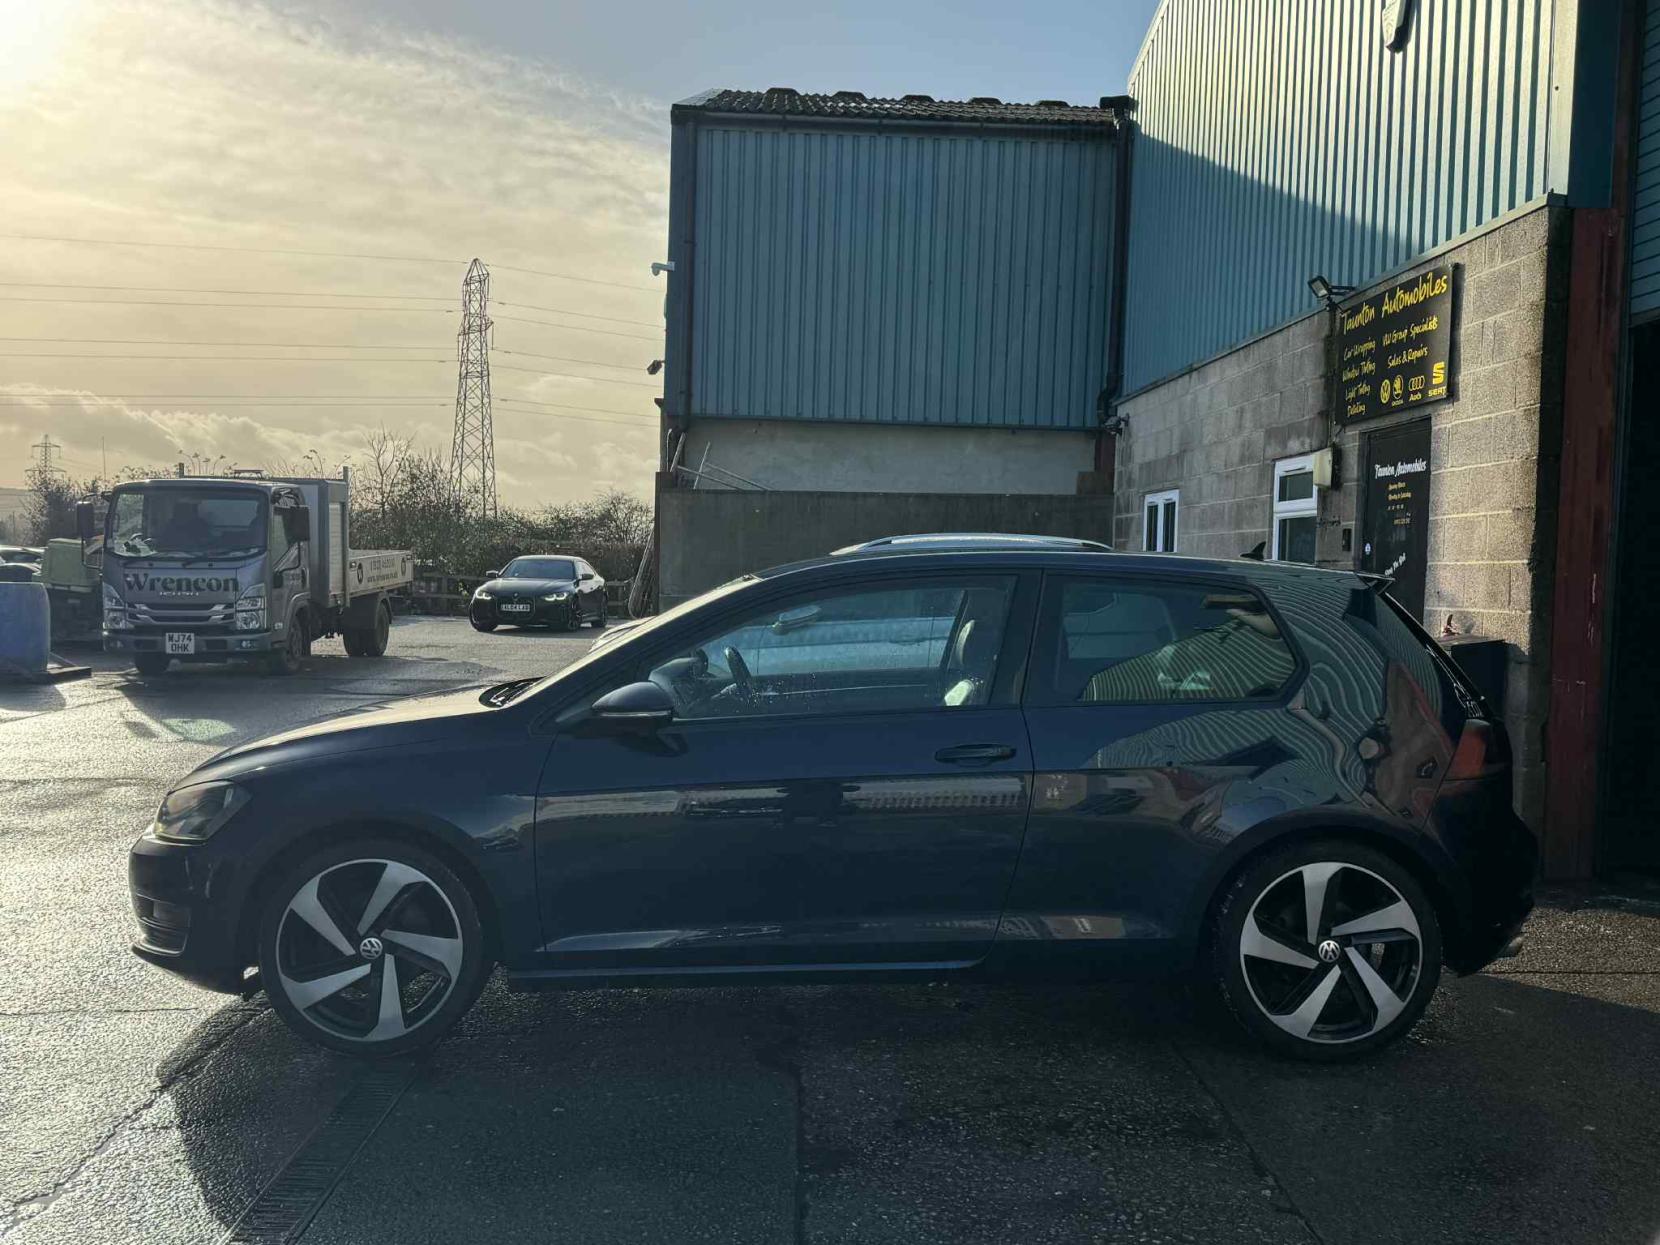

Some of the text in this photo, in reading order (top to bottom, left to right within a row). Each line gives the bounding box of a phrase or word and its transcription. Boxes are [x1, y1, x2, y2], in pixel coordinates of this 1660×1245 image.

[1341, 302, 1375, 335] Taunton
[1387, 353, 1402, 369] Sales
[1408, 343, 1428, 364] Repairs
[1428, 385, 1447, 397] SEAT
[123, 573, 239, 592] Wrencon
